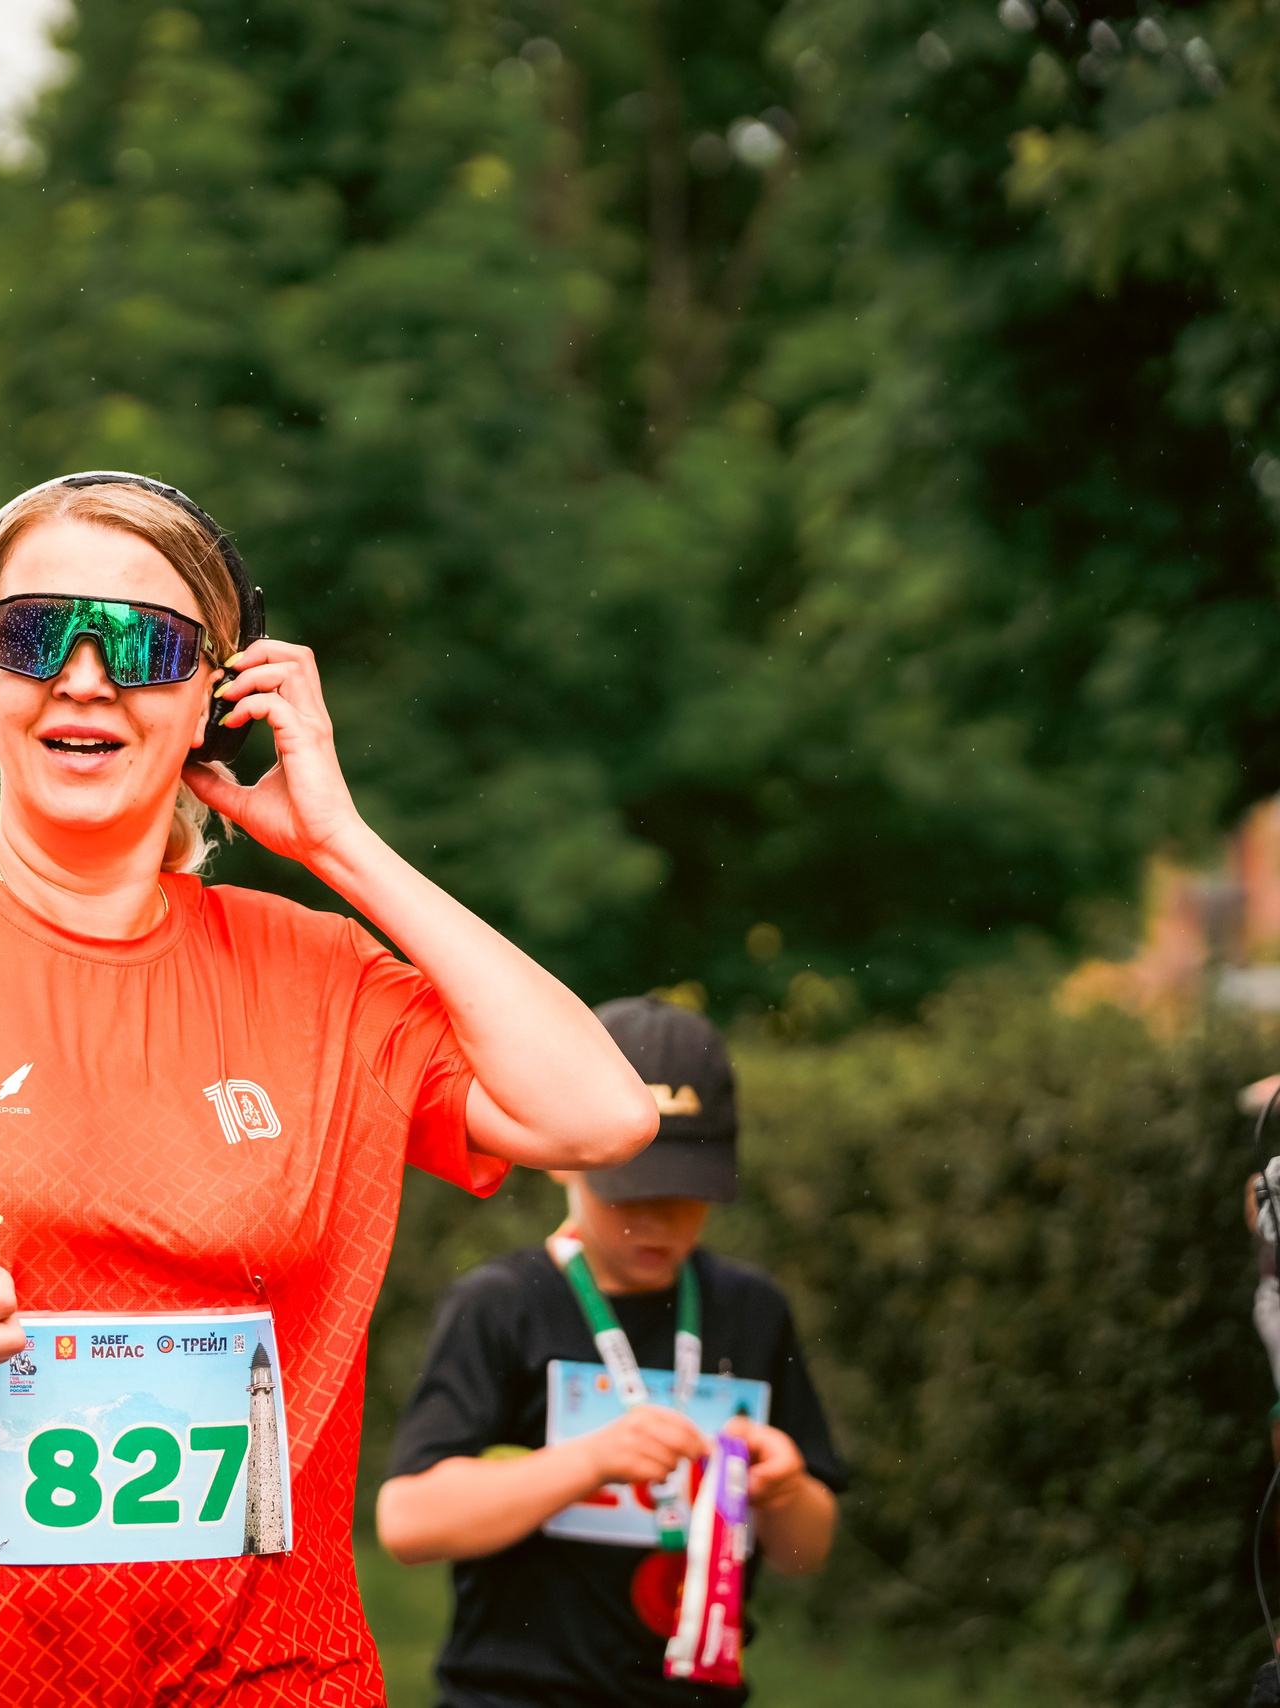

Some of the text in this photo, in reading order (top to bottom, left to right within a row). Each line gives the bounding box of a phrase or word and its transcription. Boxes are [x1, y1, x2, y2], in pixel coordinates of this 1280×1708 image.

[202, 1079, 282, 1144] 10
[91, 1335, 128, 1345] ЗАБЕГ
[91, 1345, 144, 1358] МАГАС
[25, 1425, 249, 1528] 827
